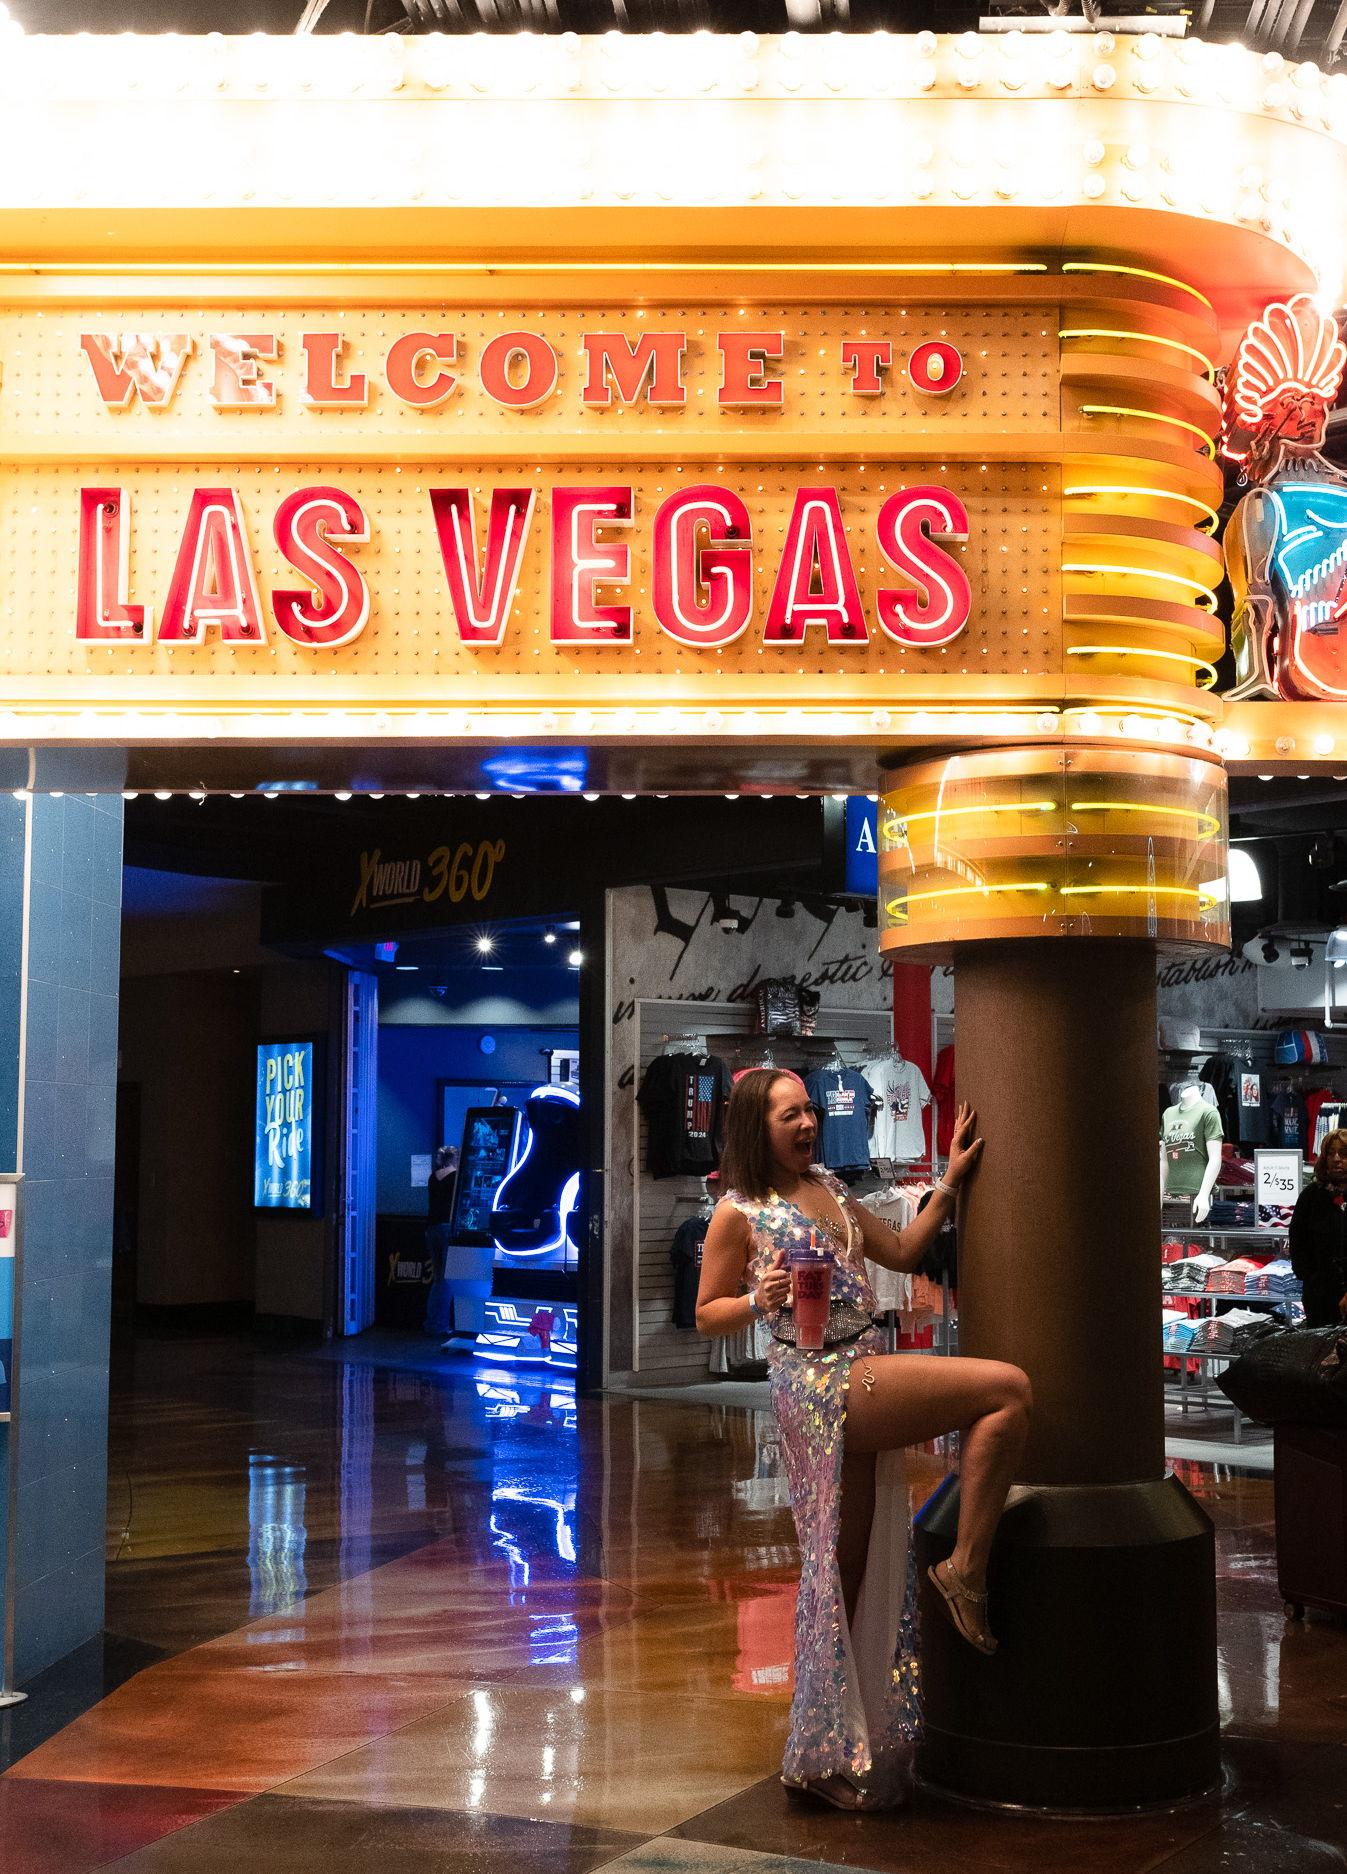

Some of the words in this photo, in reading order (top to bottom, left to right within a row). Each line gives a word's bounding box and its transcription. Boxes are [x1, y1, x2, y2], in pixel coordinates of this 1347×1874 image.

[80, 331, 785, 410] WELCOME
[841, 340, 964, 397] TO
[76, 485, 370, 648] LAS
[428, 483, 973, 649] VEGAS
[266, 1050, 305, 1095] PICK
[265, 1088, 305, 1129] YOUR
[686, 1075, 694, 1131] TRUMP
[265, 1118, 304, 1169] Ride
[1263, 1172, 1294, 1191] 2/$35
[880, 1217, 902, 1233] EGAS
[797, 1270, 825, 1281] FAT
[797, 1290, 825, 1299] DAY
